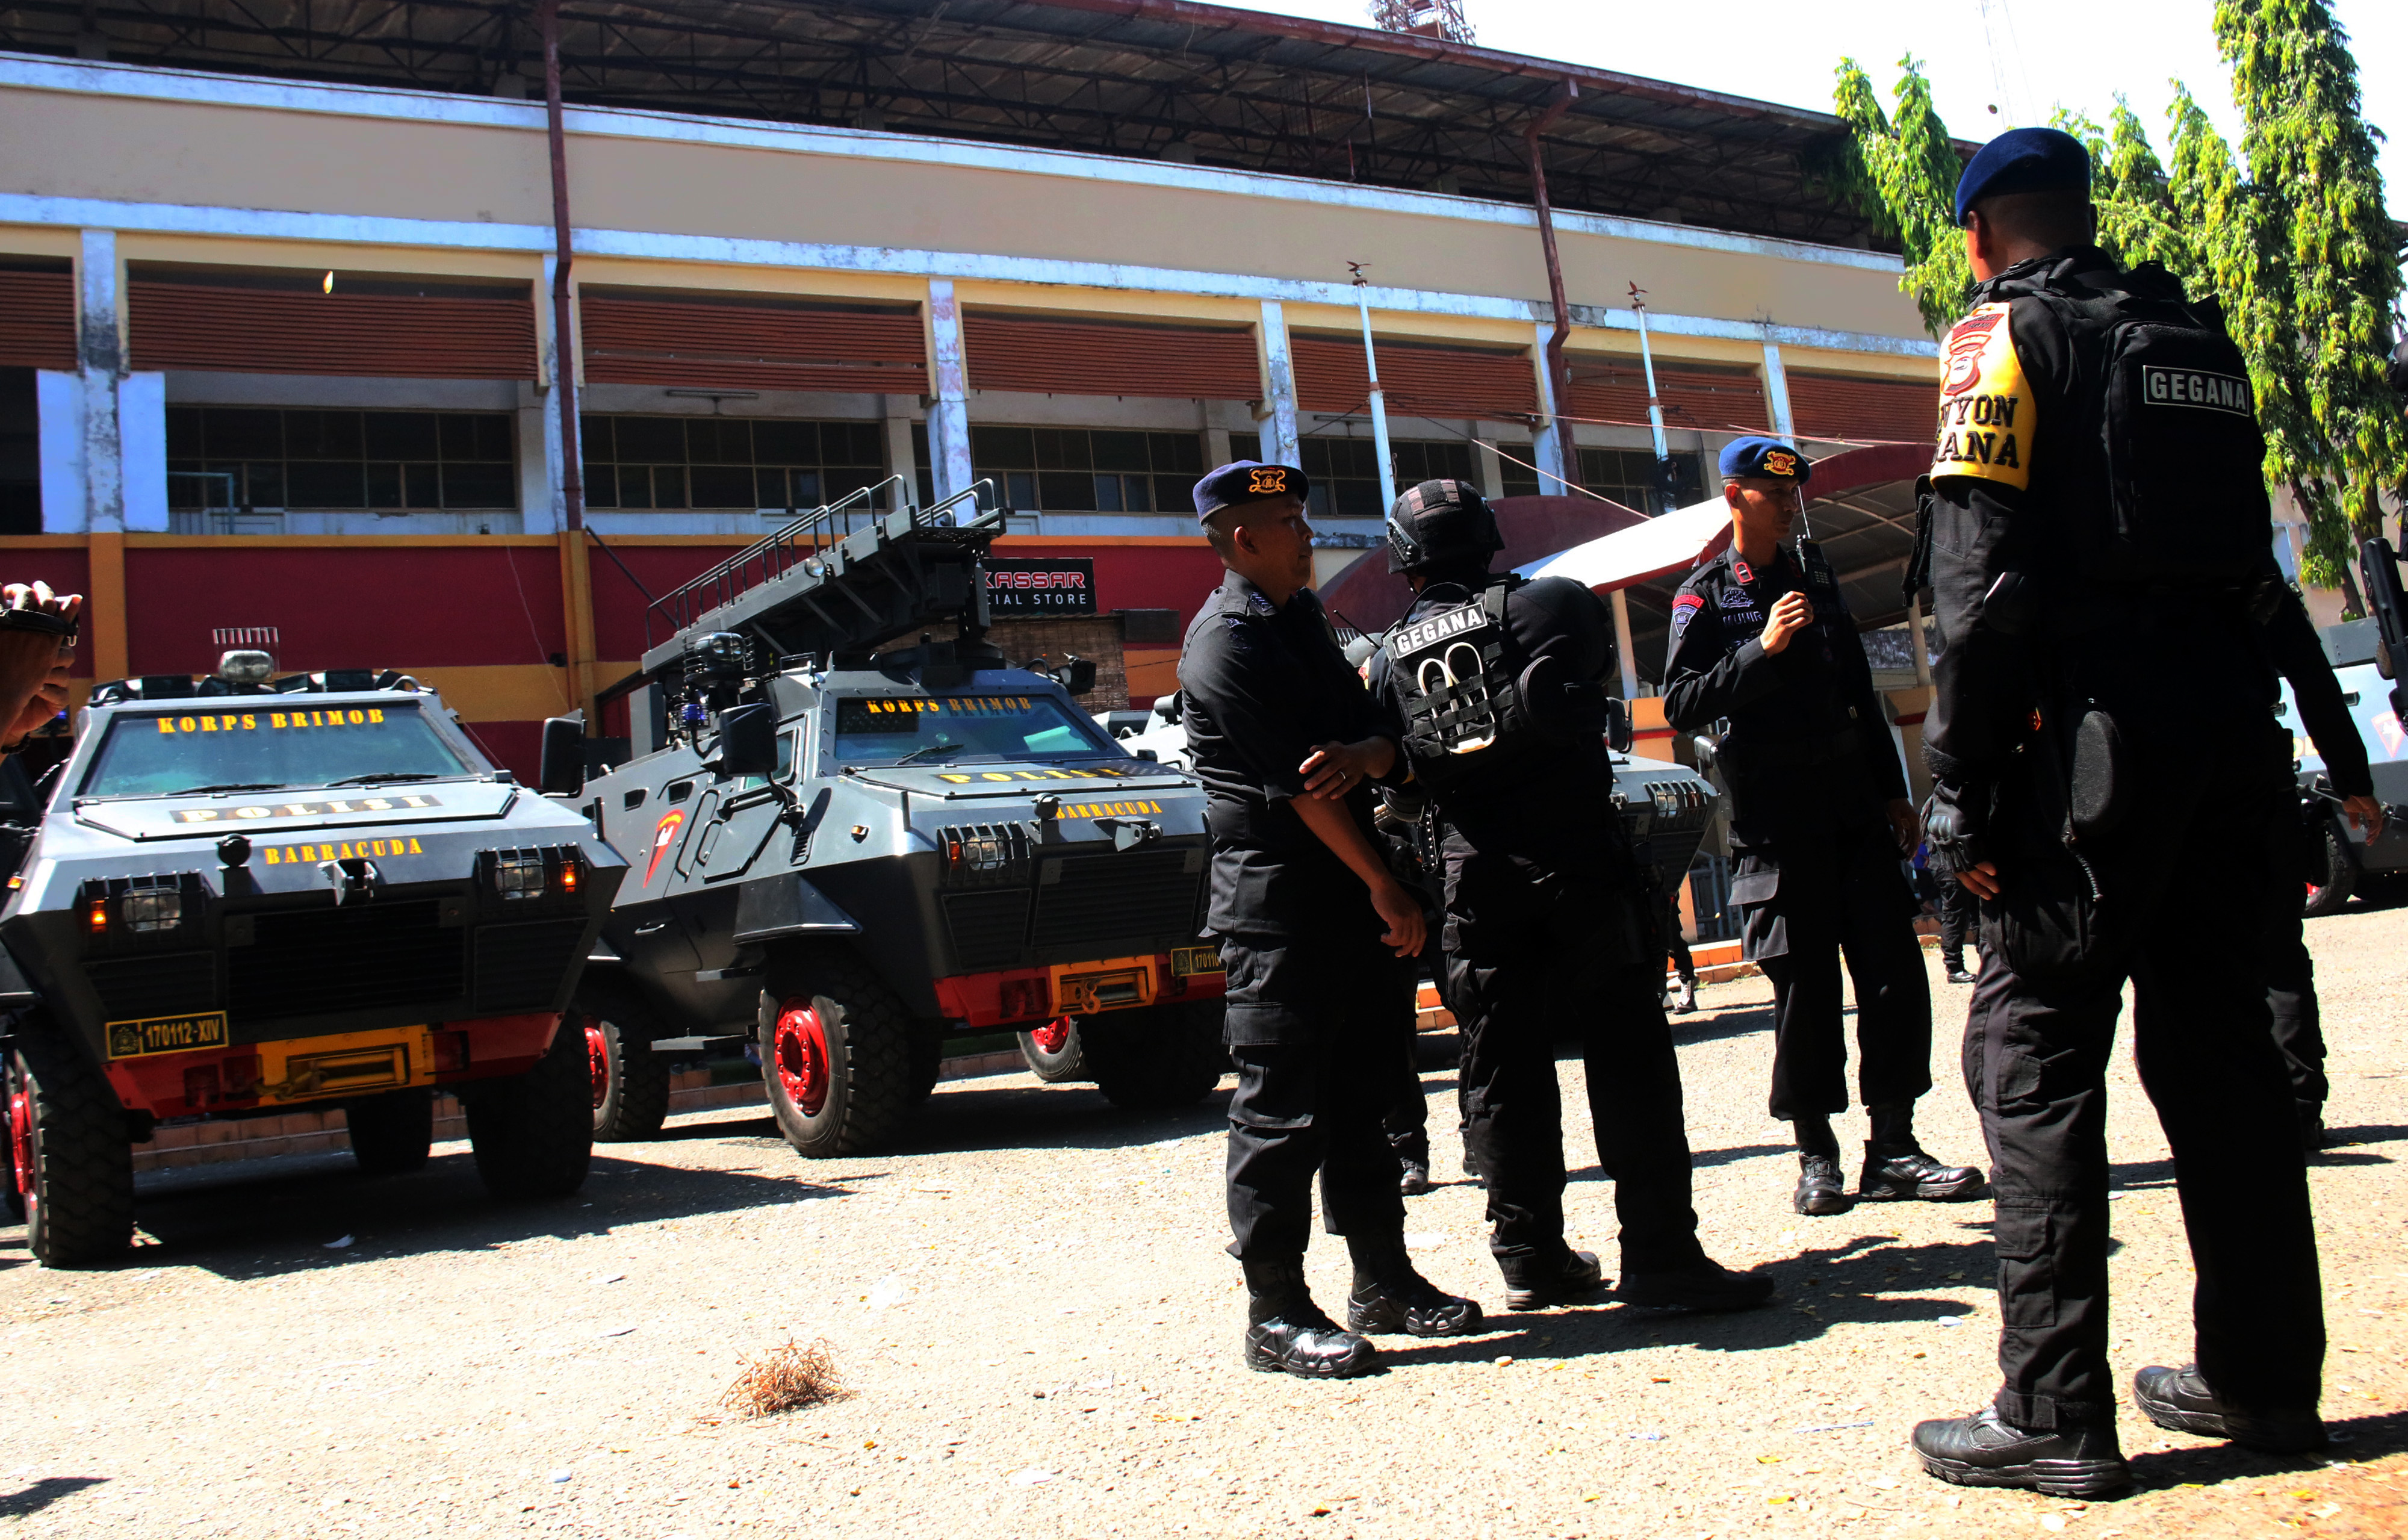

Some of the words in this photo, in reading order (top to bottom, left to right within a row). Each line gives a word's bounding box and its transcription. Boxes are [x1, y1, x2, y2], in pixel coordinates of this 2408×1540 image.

[2150, 371, 2246, 411] GEGANA
[1938, 394, 2019, 428] NYON
[1932, 430, 2020, 469] ANA
[1033, 594, 1087, 605] STORE
[1396, 608, 1482, 653] GEGANA
[866, 699, 940, 713] KORPS
[947, 697, 1032, 711] BRIMOB
[158, 714, 256, 733] KORPS
[270, 709, 385, 728] BRIMOB
[939, 768, 1125, 783] POLISI
[179, 795, 430, 822] POLISI
[1055, 800, 1163, 819] BARRACUDA
[263, 837, 423, 865] BARRACUDA
[146, 1019, 220, 1048] 170112-XIV
